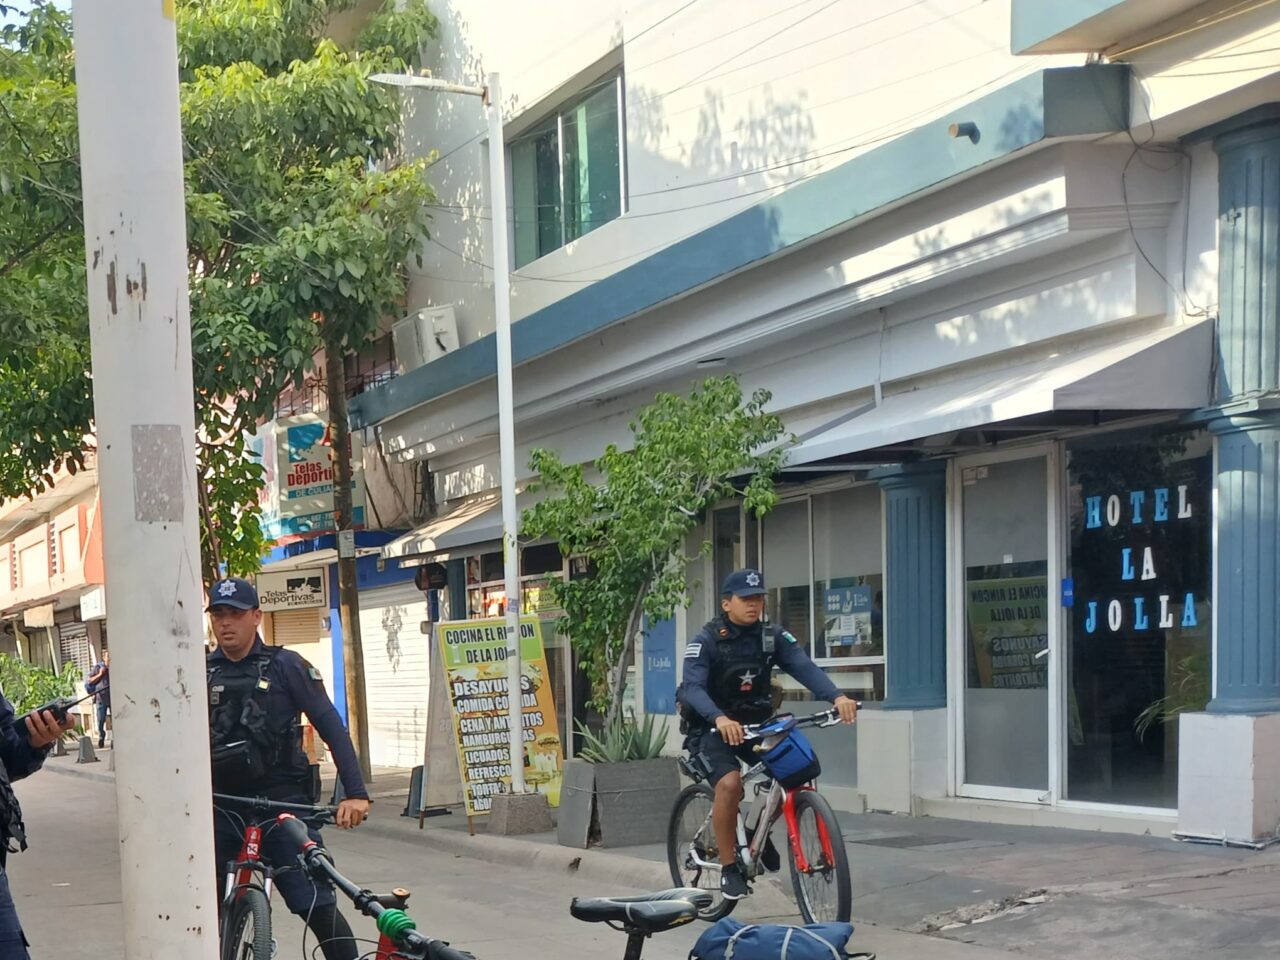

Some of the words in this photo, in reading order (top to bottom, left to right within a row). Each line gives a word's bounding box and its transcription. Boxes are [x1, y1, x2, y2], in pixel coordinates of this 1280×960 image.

[294, 462, 322, 475] Telas
[1086, 485, 1192, 529] HOTEL
[1121, 547, 1157, 581] LA
[260, 593, 315, 605] Deportivas
[265, 590, 288, 598] Telas
[1086, 593, 1198, 634] JOLLA
[446, 628, 484, 645] COCINA
[485, 627, 497, 641] EL
[497, 624, 535, 641] RION
[466, 649, 479, 663] DE
[480, 648, 493, 662] LA
[453, 675, 531, 696] DESAYUNS
[457, 697, 495, 713] COMIDA
[495, 693, 538, 711] COIDA
[460, 718, 485, 733] CENA
[485, 717, 492, 731] Y
[493, 712, 544, 730] ANTITOS
[465, 748, 510, 764] LICUADOS
